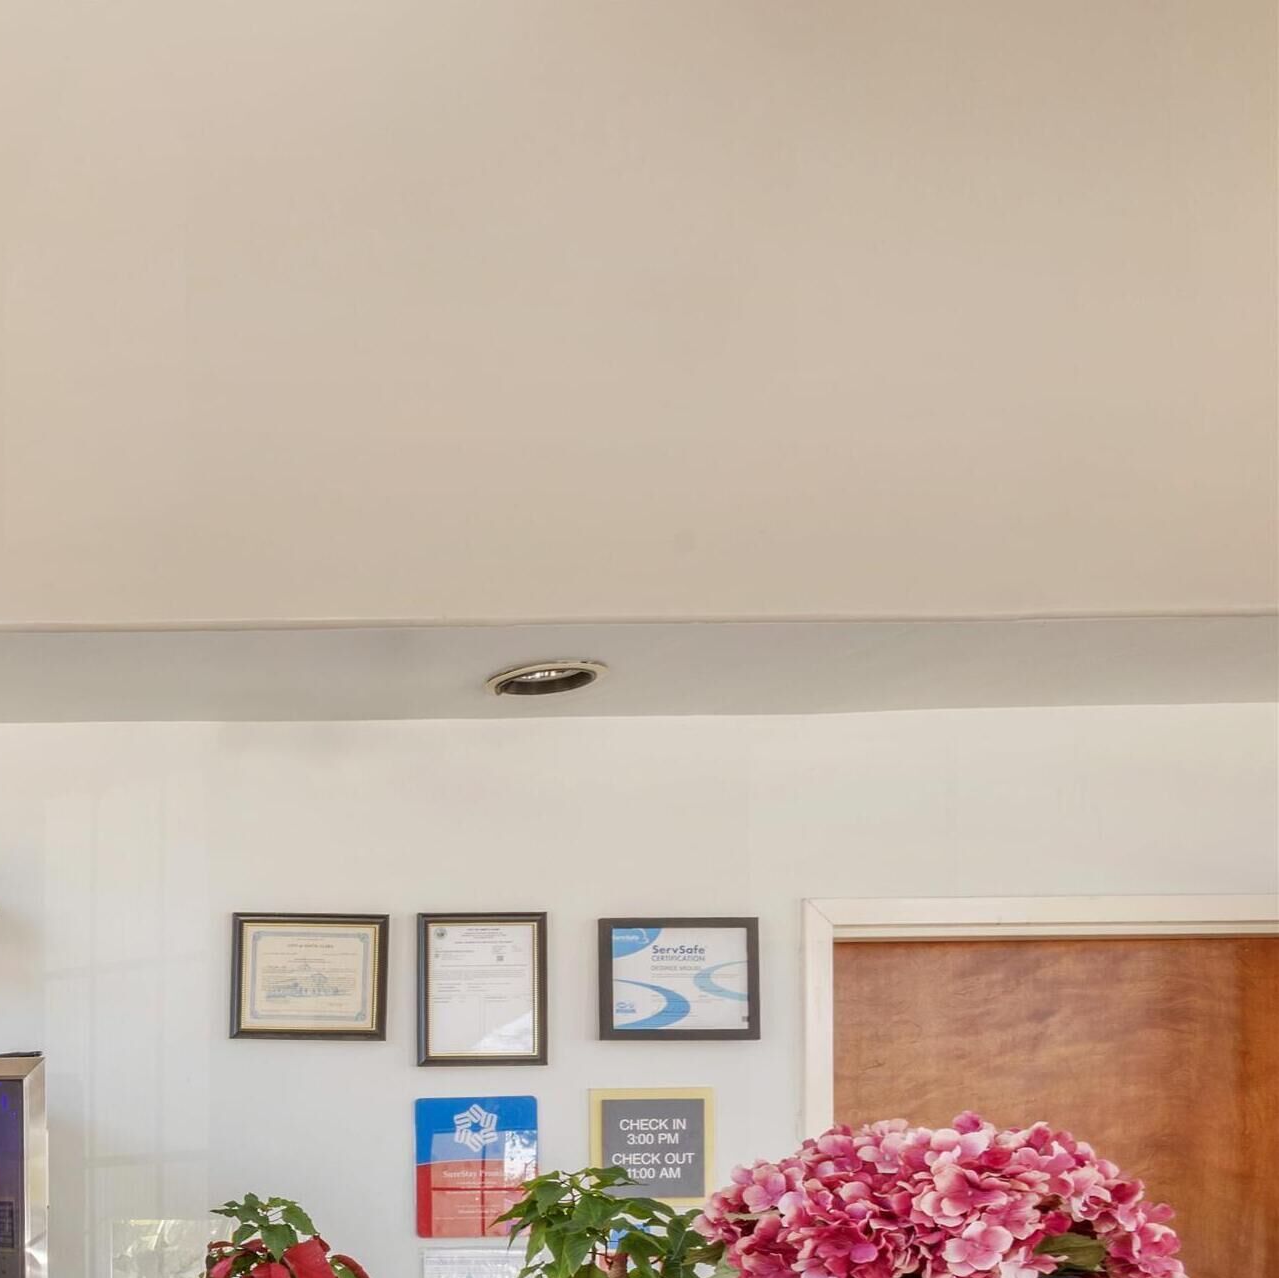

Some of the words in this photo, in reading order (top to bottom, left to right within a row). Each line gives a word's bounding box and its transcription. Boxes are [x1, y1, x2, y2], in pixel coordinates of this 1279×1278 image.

[651, 944, 706, 955] ServSafe
[650, 954, 706, 962] CERTIFICATION
[619, 1118, 670, 1131] CHECK
[672, 1118, 687, 1130] IN
[627, 1133, 655, 1145] 3:00
[658, 1133, 680, 1145] PM
[611, 1153, 661, 1165] CHECK
[664, 1152, 695, 1164] OUT
[626, 1167, 656, 1179] 11:00
[659, 1167, 682, 1179] AM
